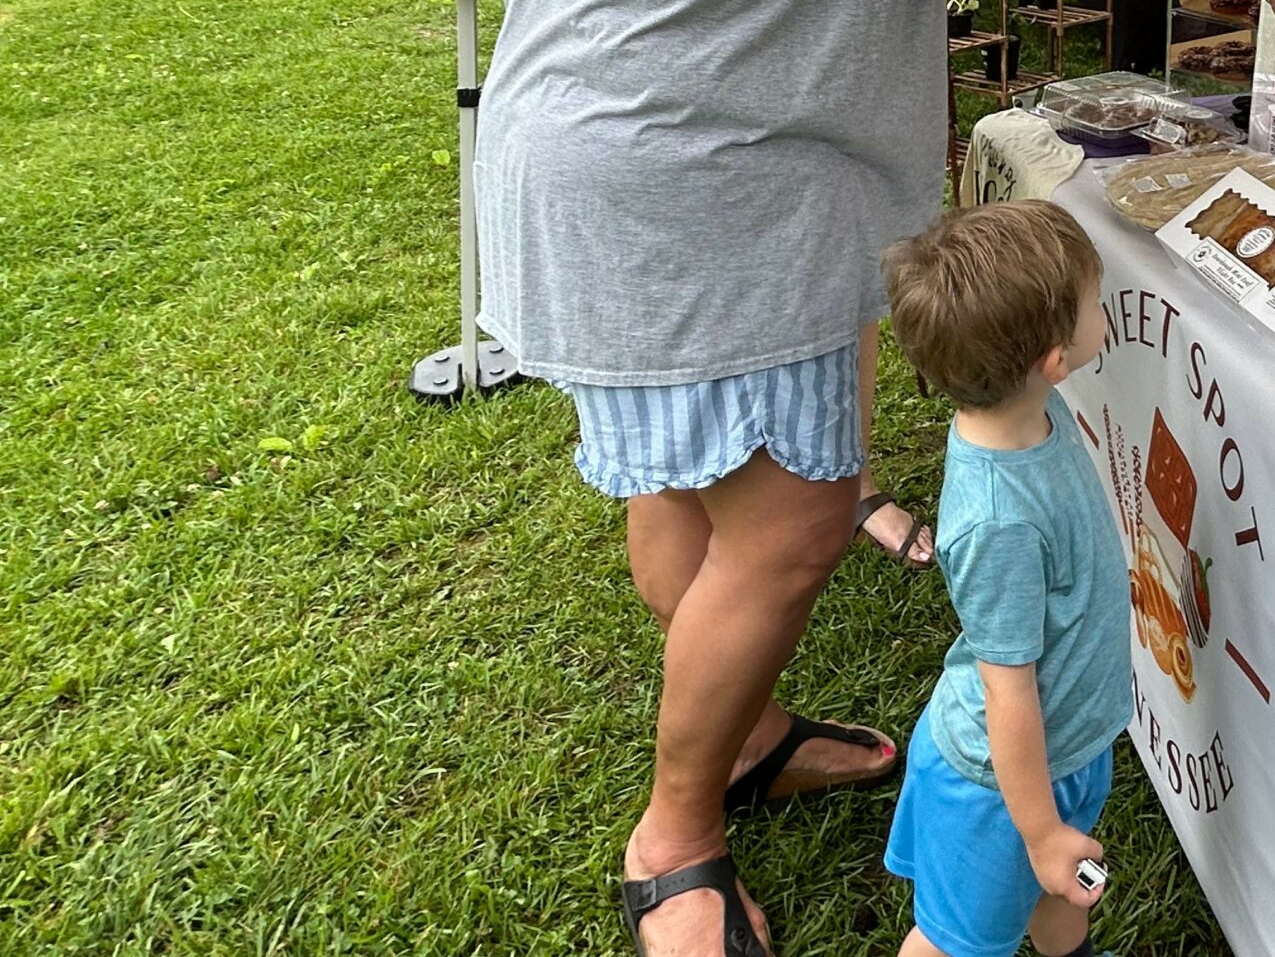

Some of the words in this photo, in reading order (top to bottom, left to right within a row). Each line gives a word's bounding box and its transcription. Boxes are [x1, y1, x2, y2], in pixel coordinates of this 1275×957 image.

[1095, 289, 1180, 374] WEET
[1186, 341, 1265, 561] SPOT
[1132, 667, 1234, 814] NESSEE
